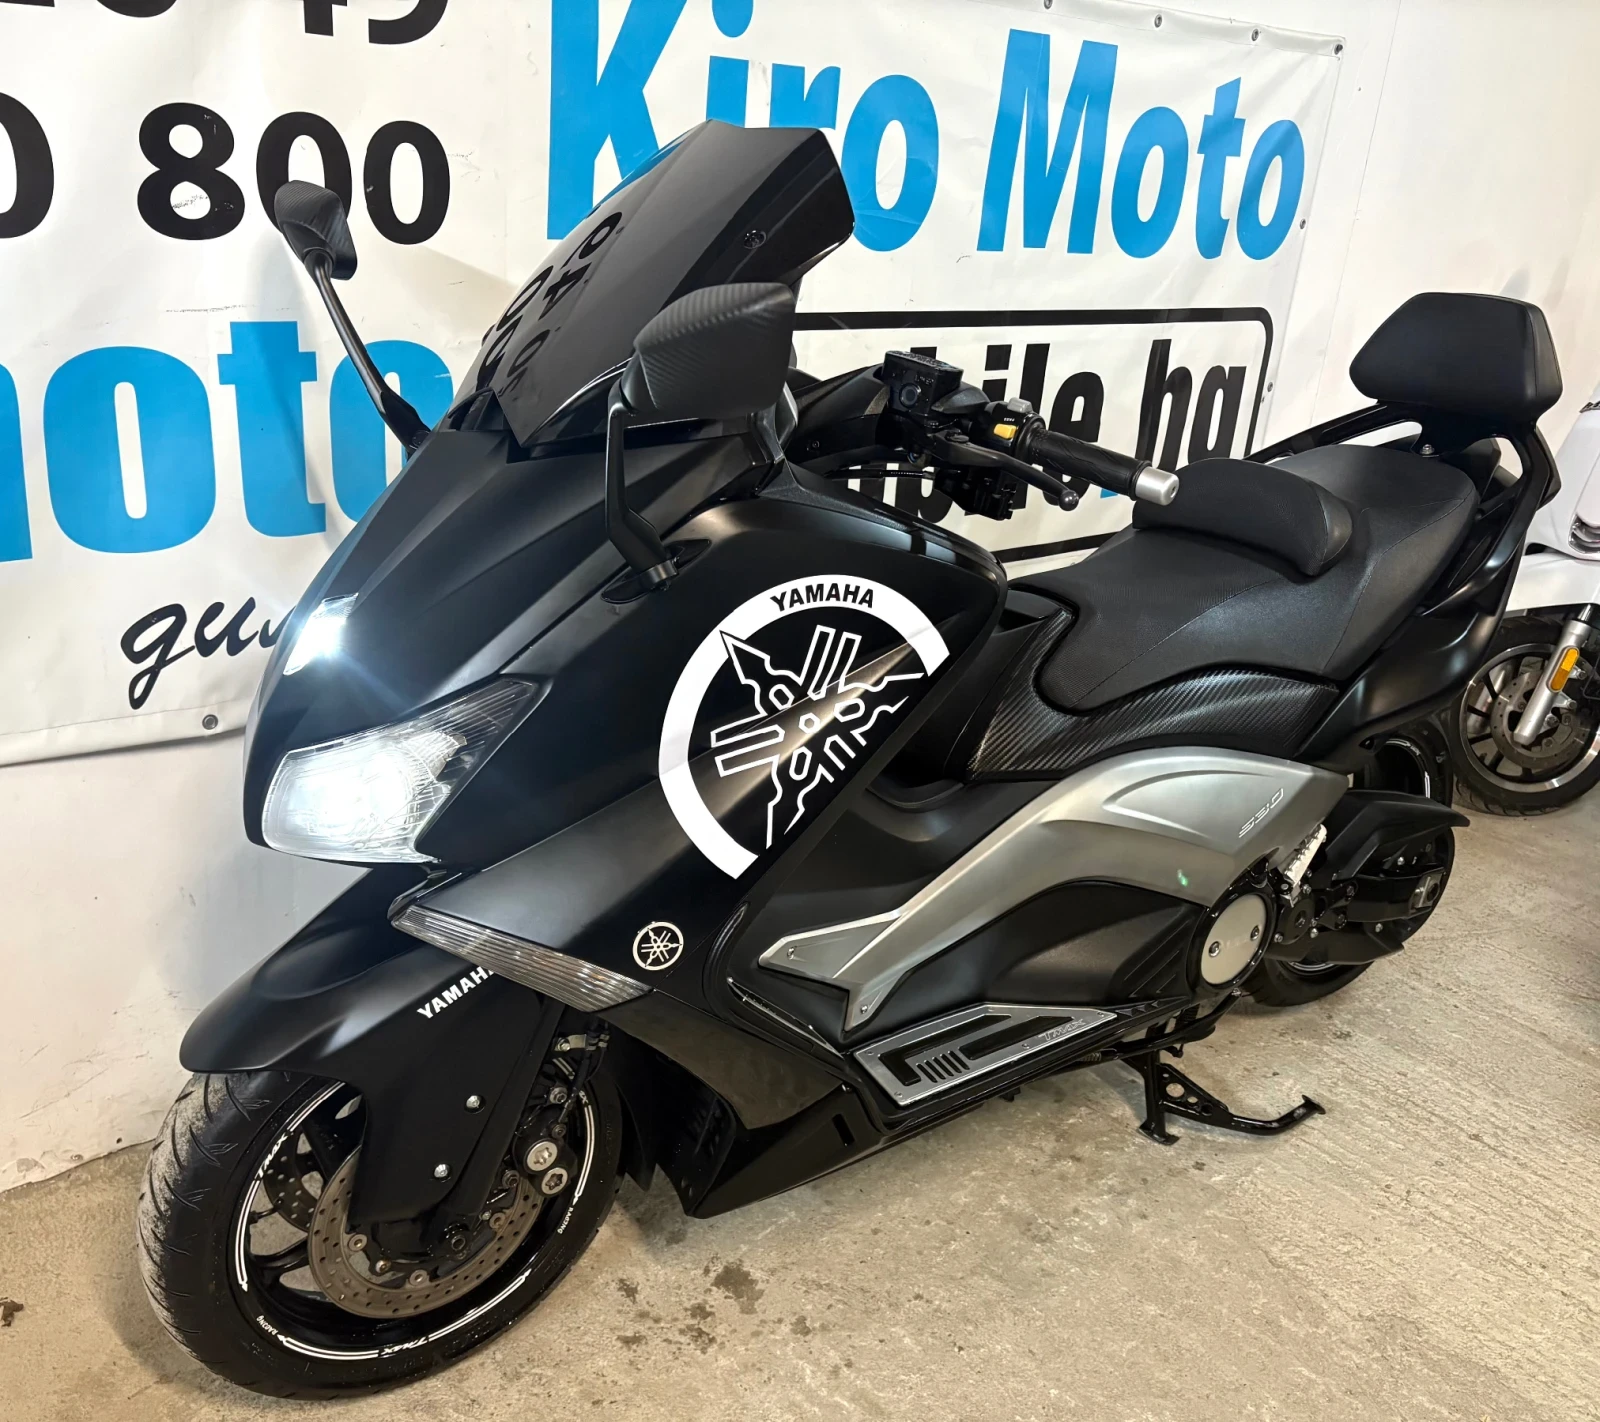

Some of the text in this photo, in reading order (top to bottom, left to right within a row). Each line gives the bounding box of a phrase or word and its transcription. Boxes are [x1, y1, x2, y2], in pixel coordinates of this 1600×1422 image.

[137, 102, 451, 245] 800
[977, 28, 1305, 260] Moto
[770, 582, 875, 612] YAMAHA
[416, 965, 495, 1019] YAMAH
